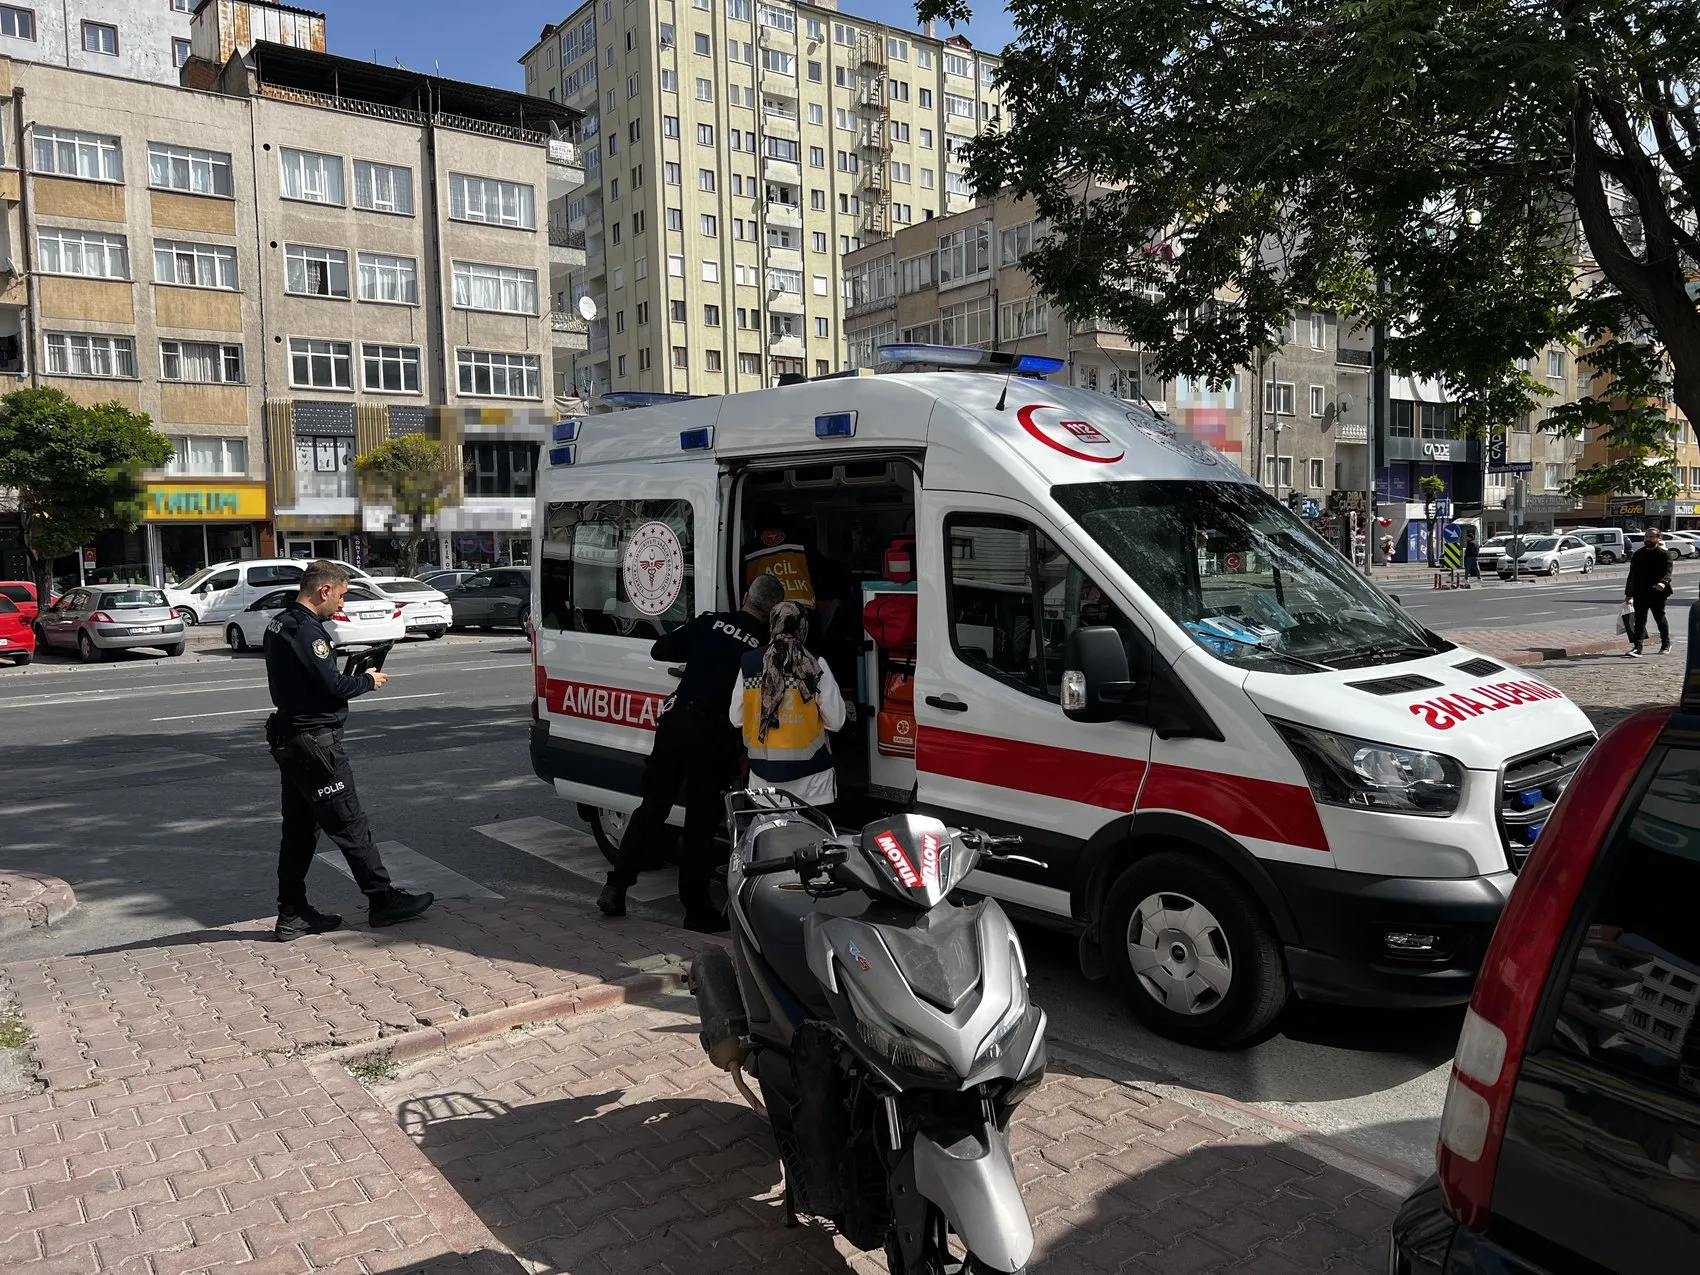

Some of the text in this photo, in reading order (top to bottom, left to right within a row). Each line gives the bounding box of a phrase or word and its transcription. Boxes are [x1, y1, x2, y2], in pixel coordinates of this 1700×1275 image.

[1066, 423, 1096, 435] 112
[1620, 505, 1643, 514] Büfe
[878, 836, 918, 888] MOTUL
[922, 834, 938, 885] MOTU
